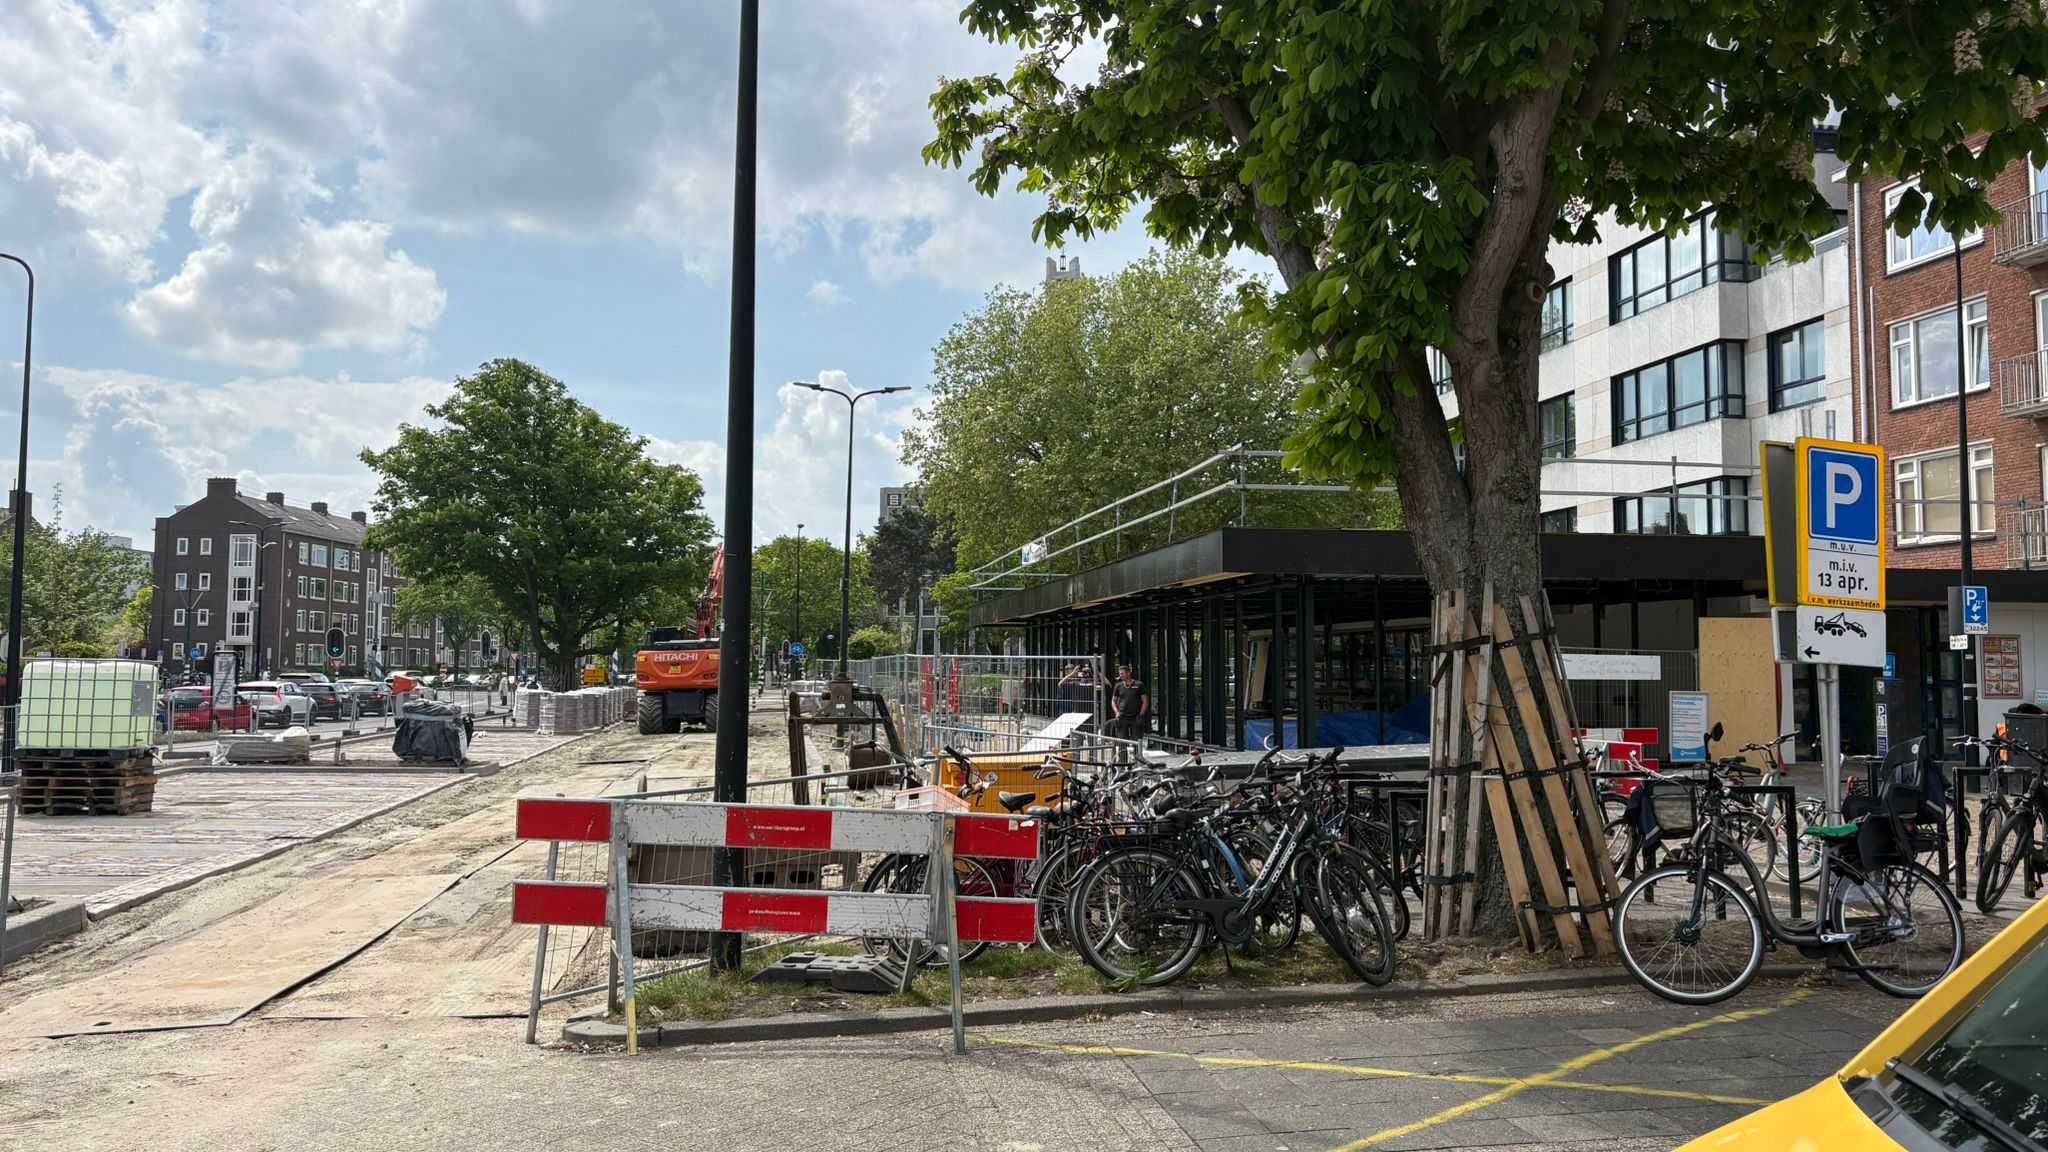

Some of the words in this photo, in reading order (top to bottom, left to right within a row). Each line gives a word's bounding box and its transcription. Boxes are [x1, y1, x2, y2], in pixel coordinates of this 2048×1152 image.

[1825, 461, 1863, 529] P
[1829, 542, 1857, 552] m.u.v.
[1829, 559, 1858, 573] m.i.v.
[1818, 572, 1832, 587] 13
[1838, 575, 1868, 594] apr.
[1827, 598, 1880, 609] werkzaamheden
[1966, 589, 1977, 606] P
[654, 652, 698, 662] HITACHI
[1259, 843, 1282, 880] COLORADO
[1271, 841, 1297, 883] COLORADO
